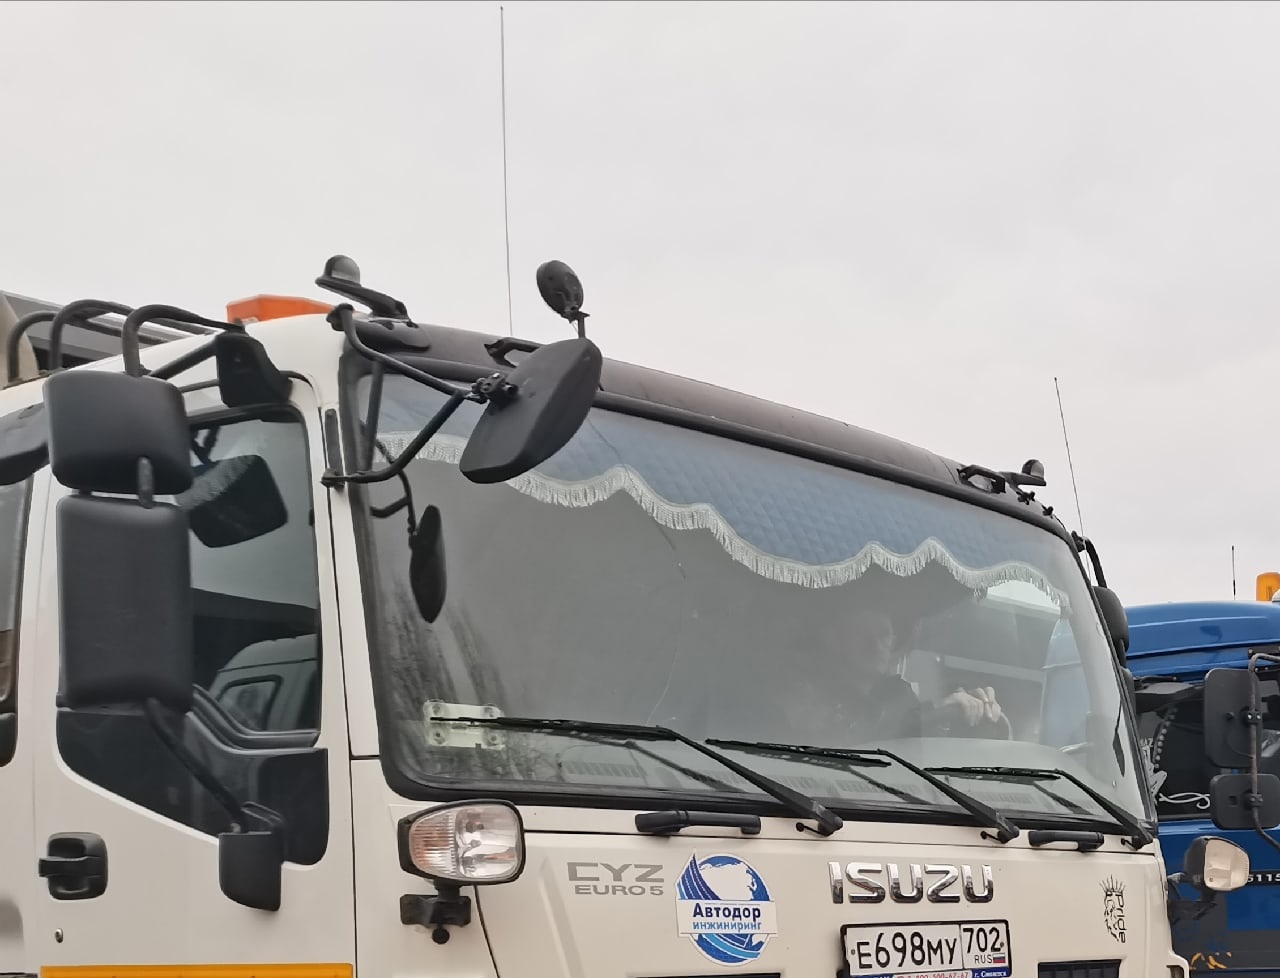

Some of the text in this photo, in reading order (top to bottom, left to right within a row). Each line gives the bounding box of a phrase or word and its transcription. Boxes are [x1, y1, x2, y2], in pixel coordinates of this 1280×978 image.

[567, 862, 664, 883] CYZ
[575, 885, 664, 896] EURO 5
[828, 862, 994, 904] ISUZU
[693, 902, 761, 922] Автодор
[1114, 894, 1127, 943] Pride
[693, 921, 762, 933] инжиниринг
[962, 926, 1001, 953] 702
[974, 955, 993, 964] RUS
